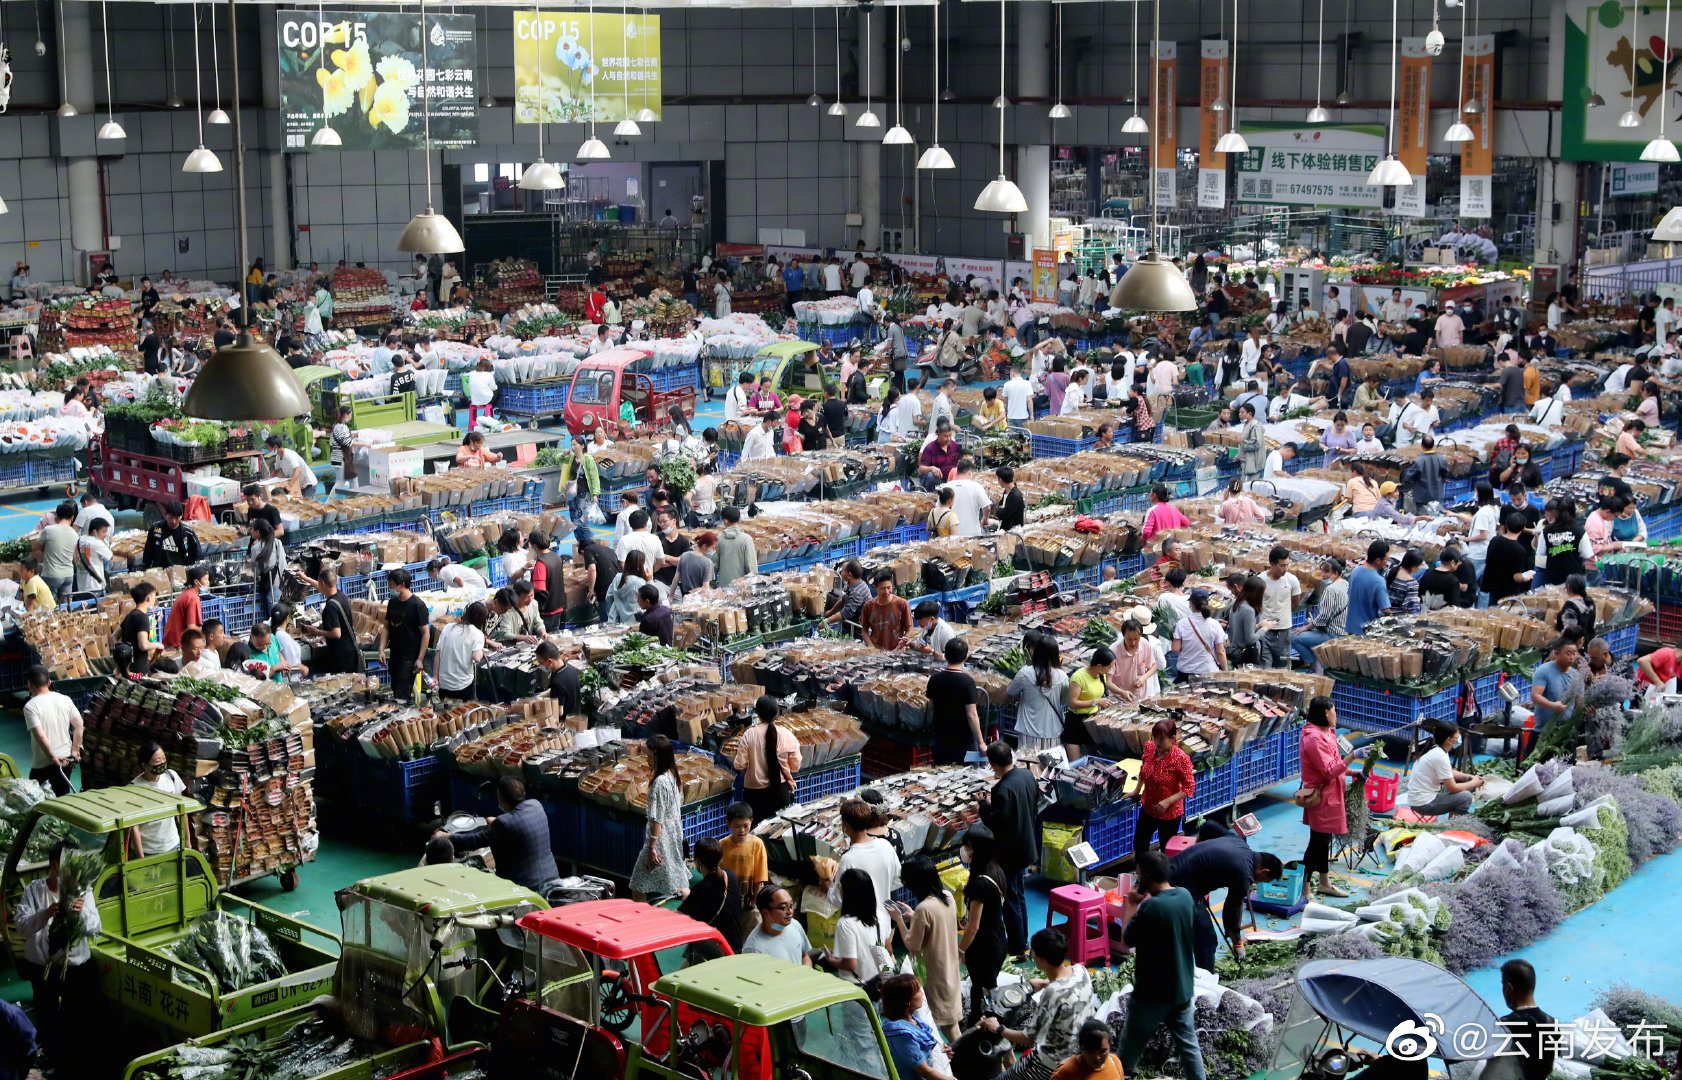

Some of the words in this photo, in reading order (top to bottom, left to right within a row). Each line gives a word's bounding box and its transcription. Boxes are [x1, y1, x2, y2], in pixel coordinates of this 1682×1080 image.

[1271, 151, 1379, 172] 线下体验销售区
[1290, 183, 1334, 196] 67497575
[124, 974, 152, 1007] 斗南
[159, 988, 190, 1025] 花卉
